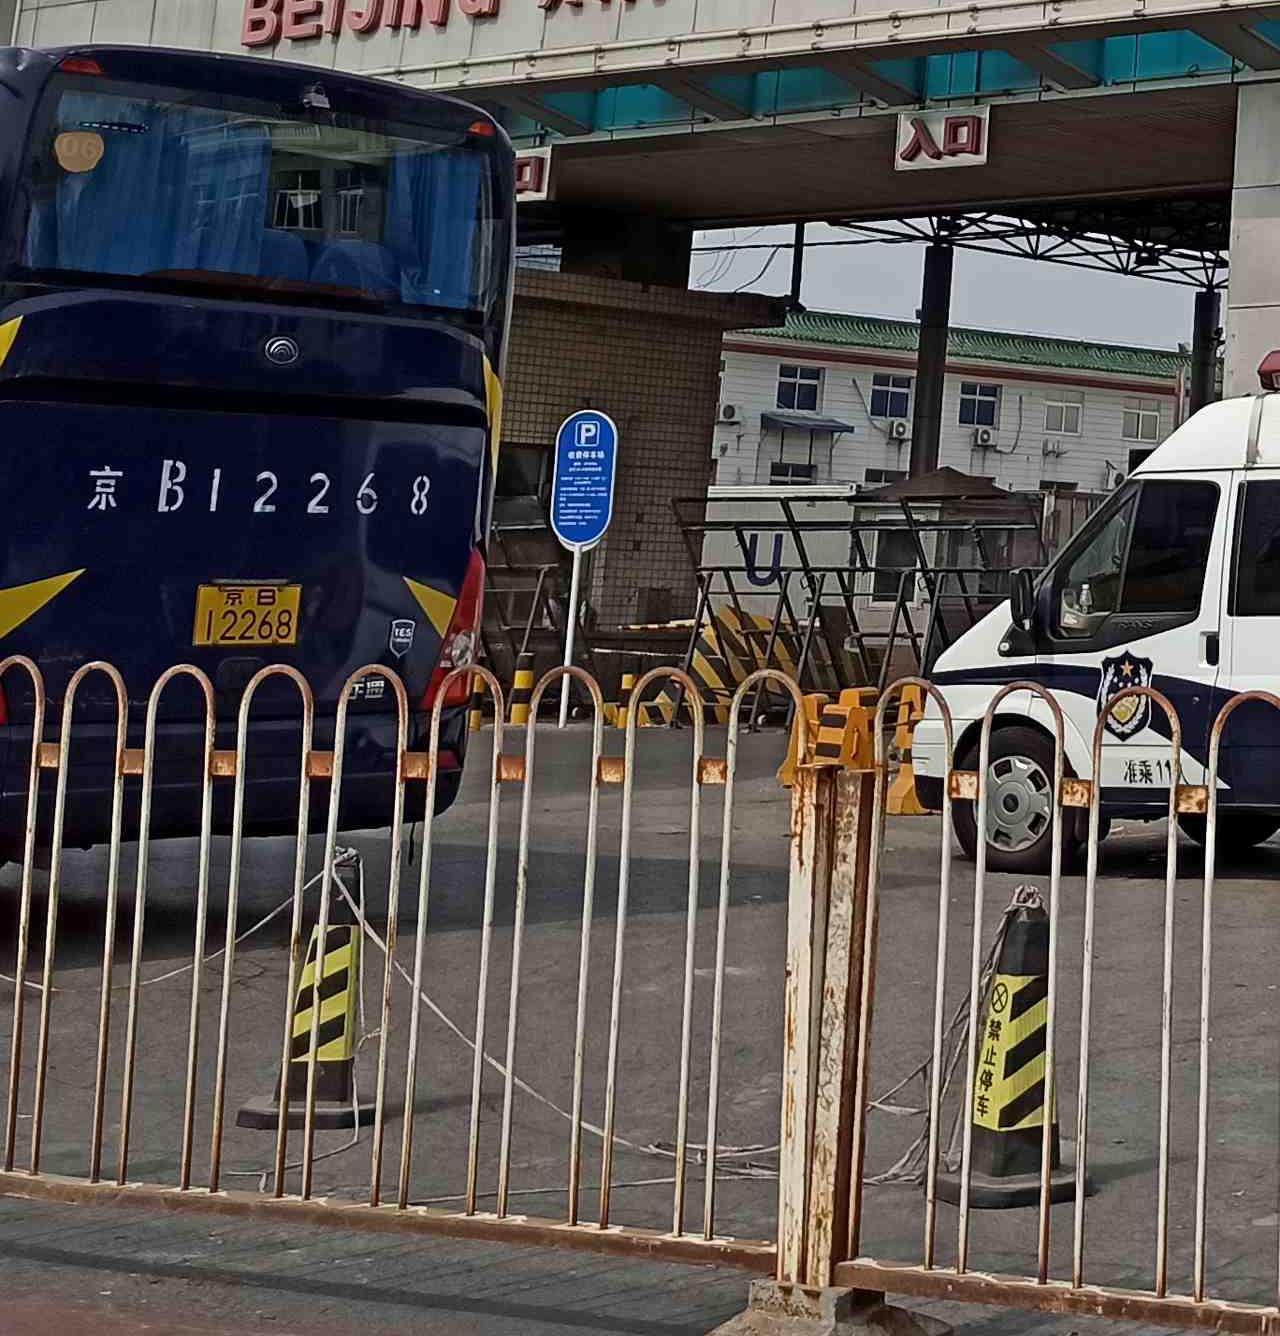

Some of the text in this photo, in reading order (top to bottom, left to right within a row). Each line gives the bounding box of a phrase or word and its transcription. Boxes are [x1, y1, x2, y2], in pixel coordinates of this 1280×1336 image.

[900, 115, 984, 161] 入口
[580, 424, 597, 445] P
[206, 609, 292, 641] 12268
[976, 1019, 1003, 1118] 禁止停车
